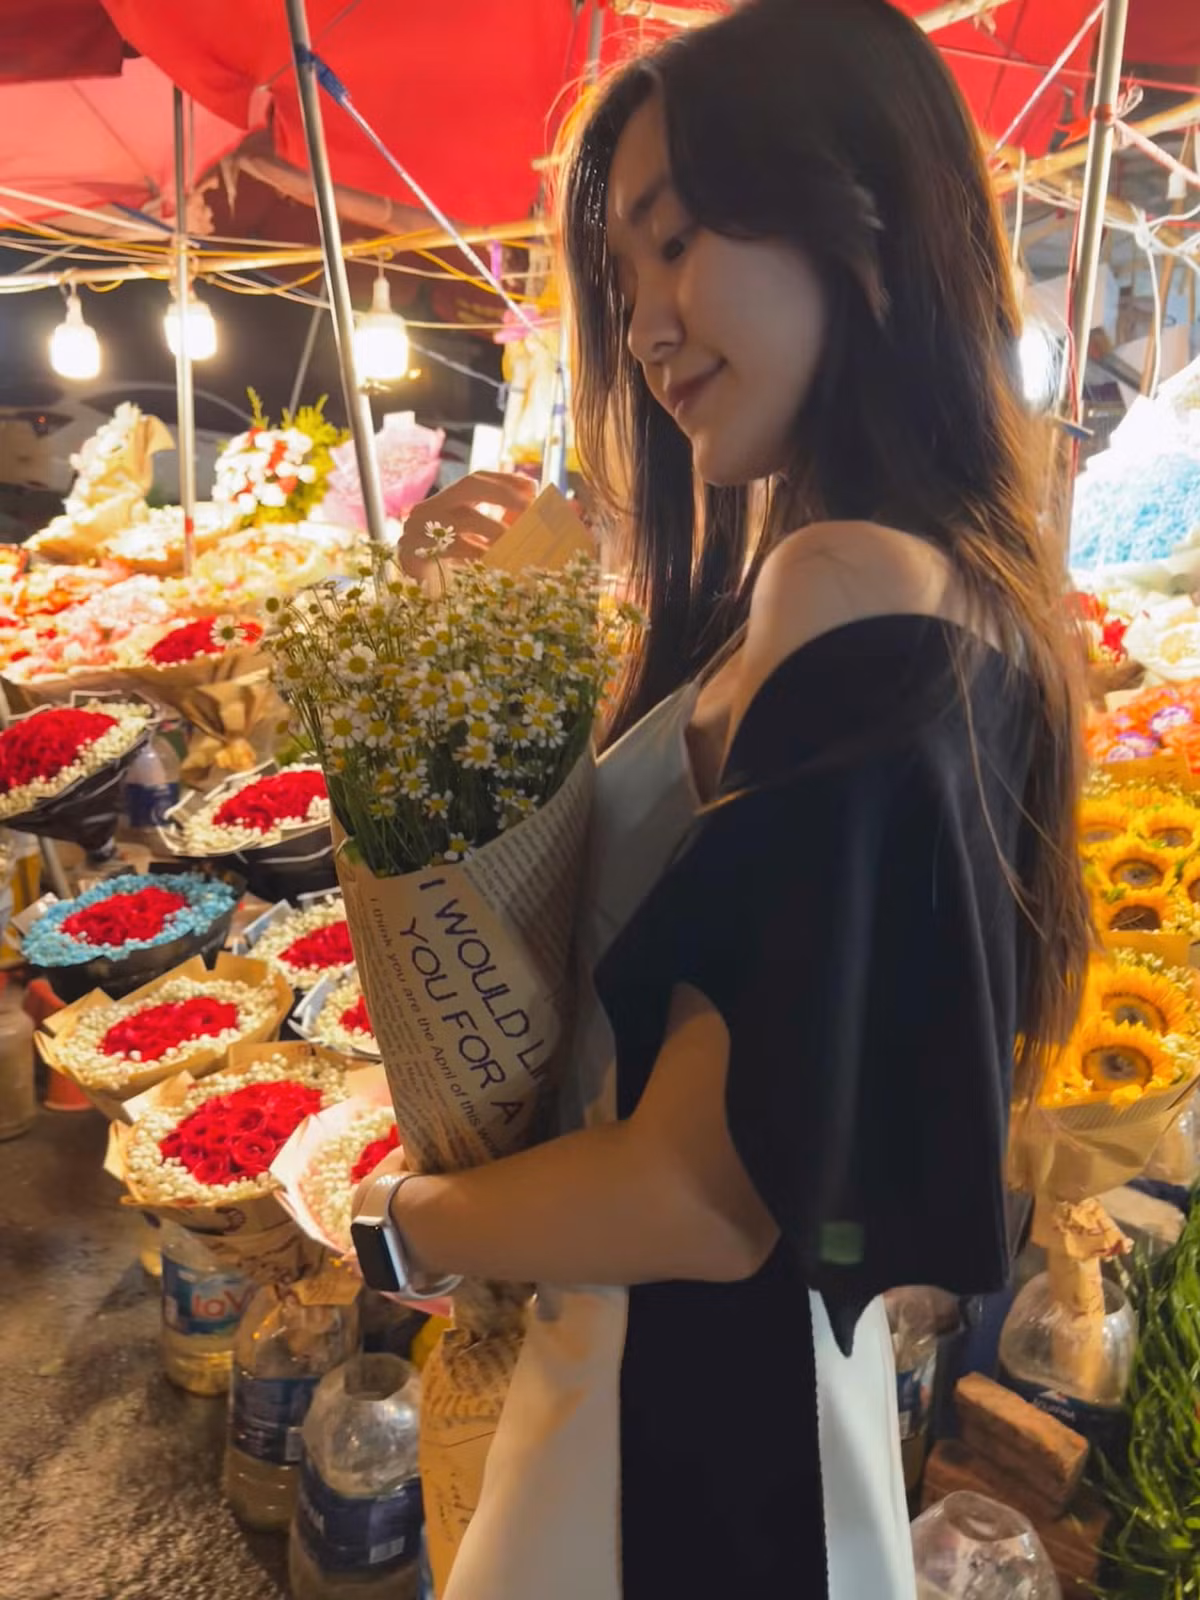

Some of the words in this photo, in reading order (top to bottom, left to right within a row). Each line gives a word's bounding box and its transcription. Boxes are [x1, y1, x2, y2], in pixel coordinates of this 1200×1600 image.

[373, 908, 393, 947] think
[387, 952, 407, 983] you
[402, 988, 422, 1013] are
[417, 1018, 435, 1042] the
[430, 1045, 458, 1080] April
[450, 1083, 469, 1097] of
[460, 1100, 480, 1127] this
[399, 915, 459, 1002] YOU
[441, 1009, 506, 1090] FOR
[490, 1101, 525, 1126] A
[419, 878, 446, 891] I
[434, 898, 530, 1038] WOULD
